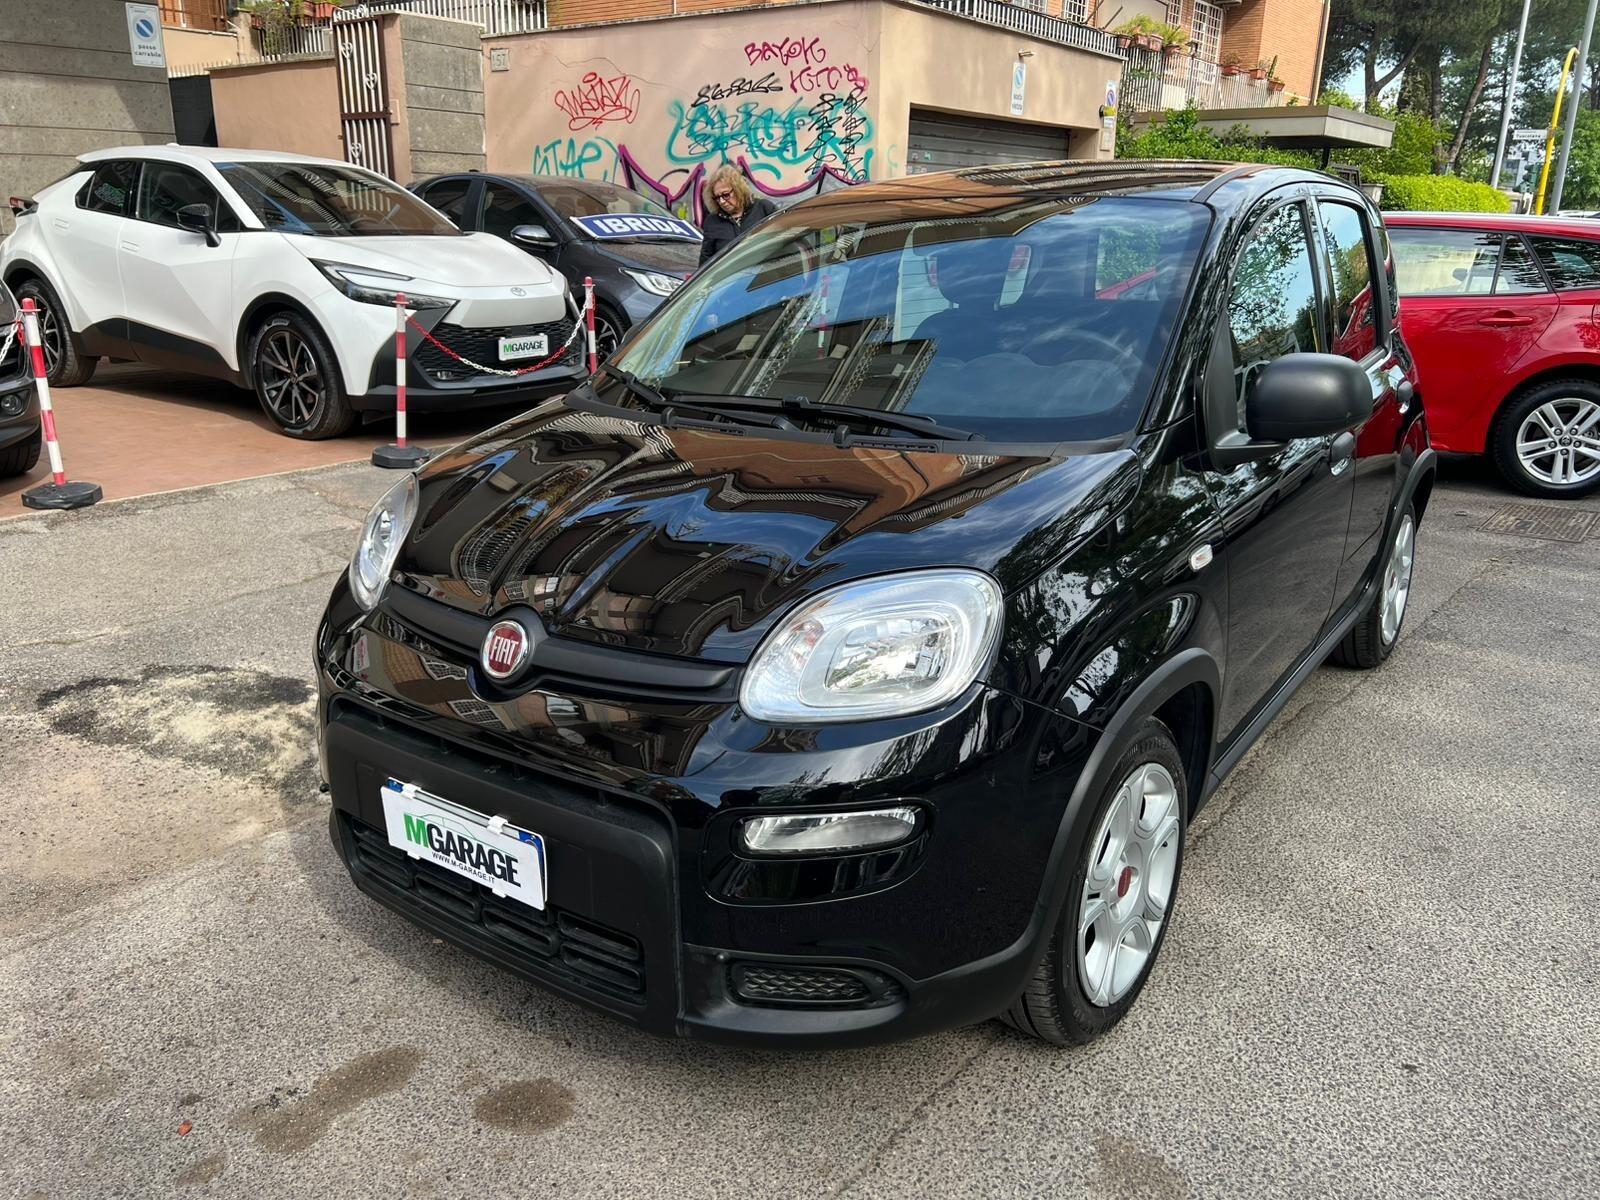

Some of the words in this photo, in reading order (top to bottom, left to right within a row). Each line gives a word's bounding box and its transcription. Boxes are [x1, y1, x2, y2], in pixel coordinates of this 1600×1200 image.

[592, 217, 691, 236] IBRIDA
[503, 340, 545, 353] MGARAGE
[490, 635, 520, 666] FIAT
[403, 813, 522, 888] MGARAGE
[431, 851, 496, 885] WWW.M-GARAGE.IT
